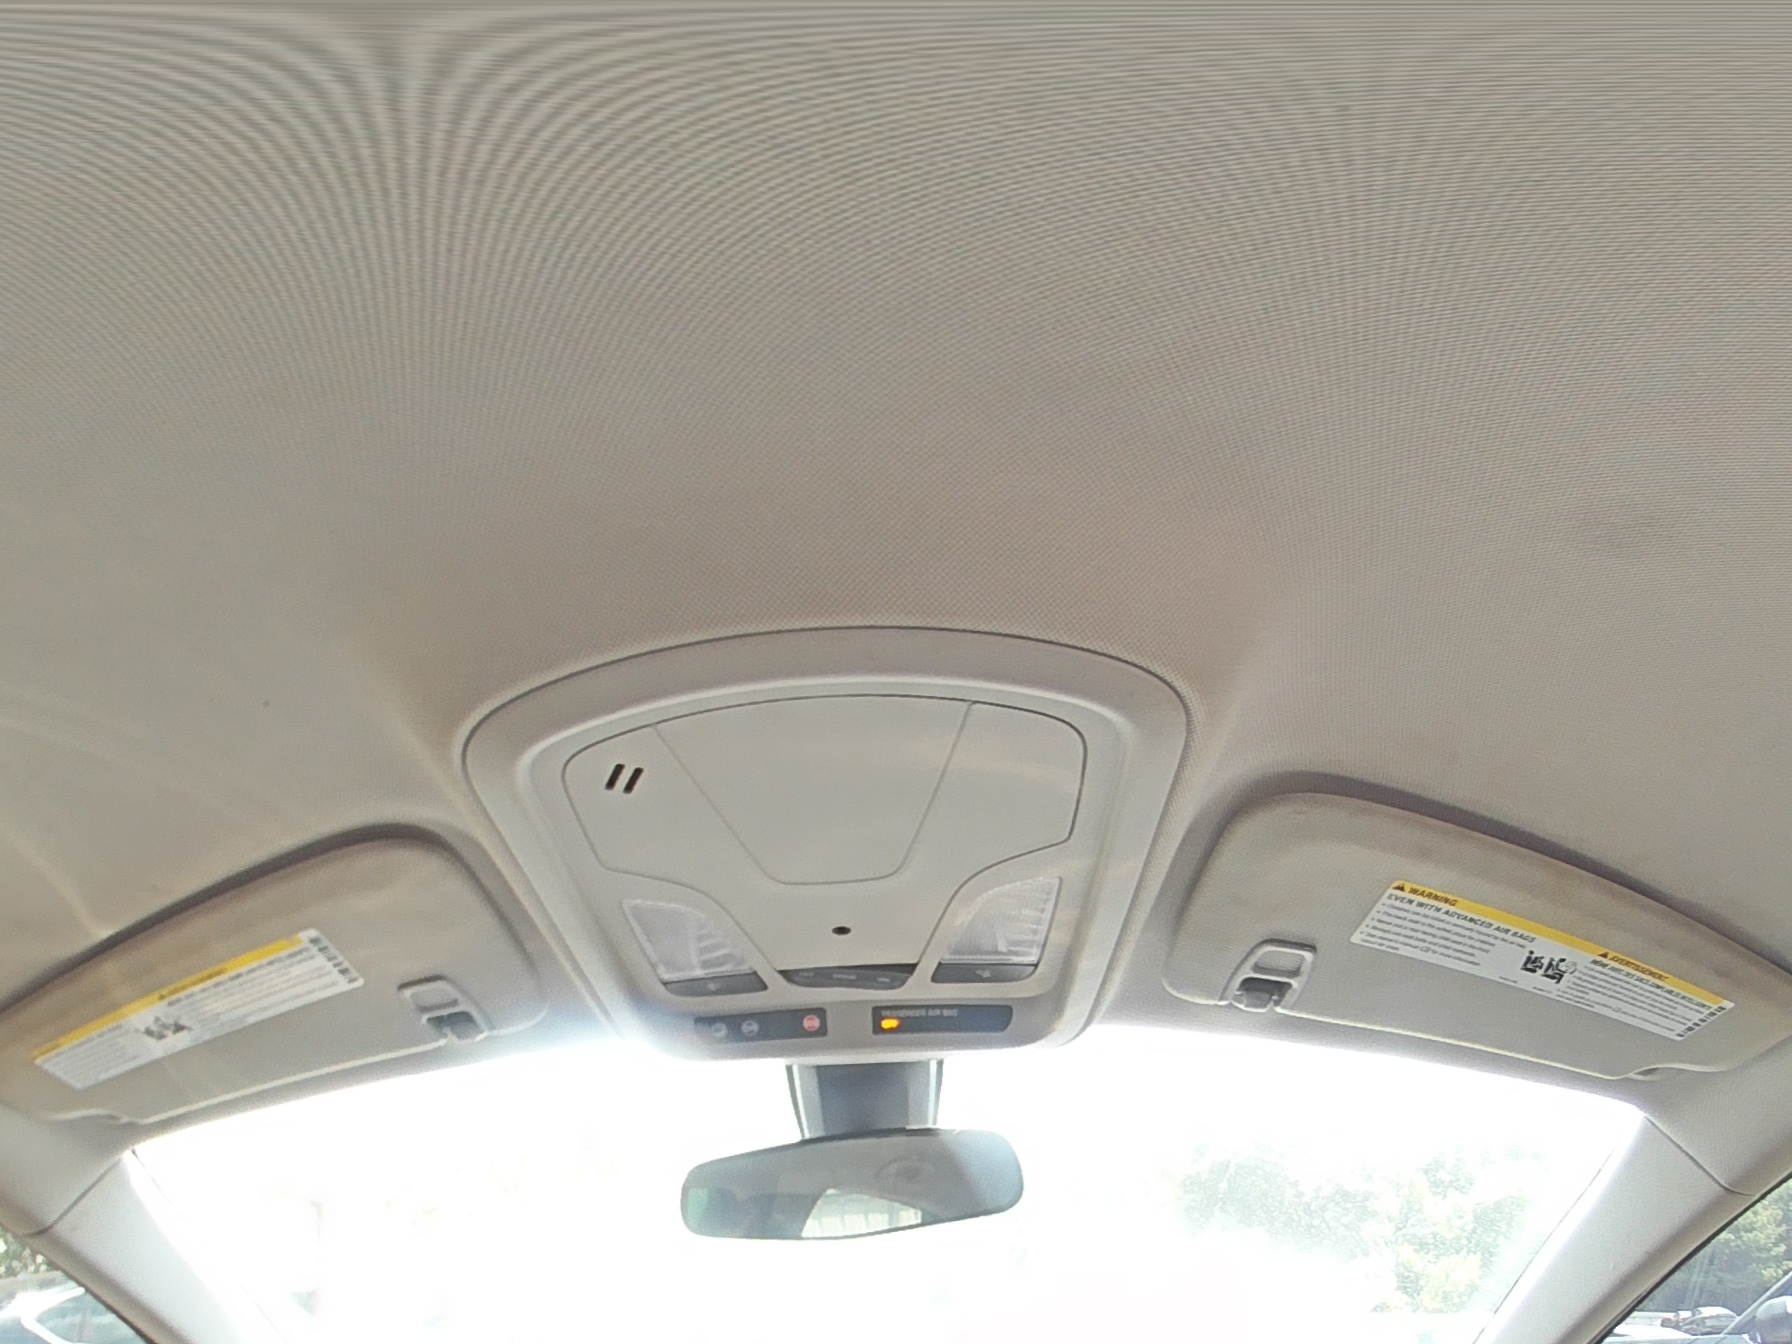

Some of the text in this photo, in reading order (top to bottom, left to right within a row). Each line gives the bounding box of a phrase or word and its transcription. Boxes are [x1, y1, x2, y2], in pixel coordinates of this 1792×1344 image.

[1408, 886, 1458, 907] WARNING
[1386, 893, 1537, 943] EVEN WITH ADVANCED AIR BAGS
